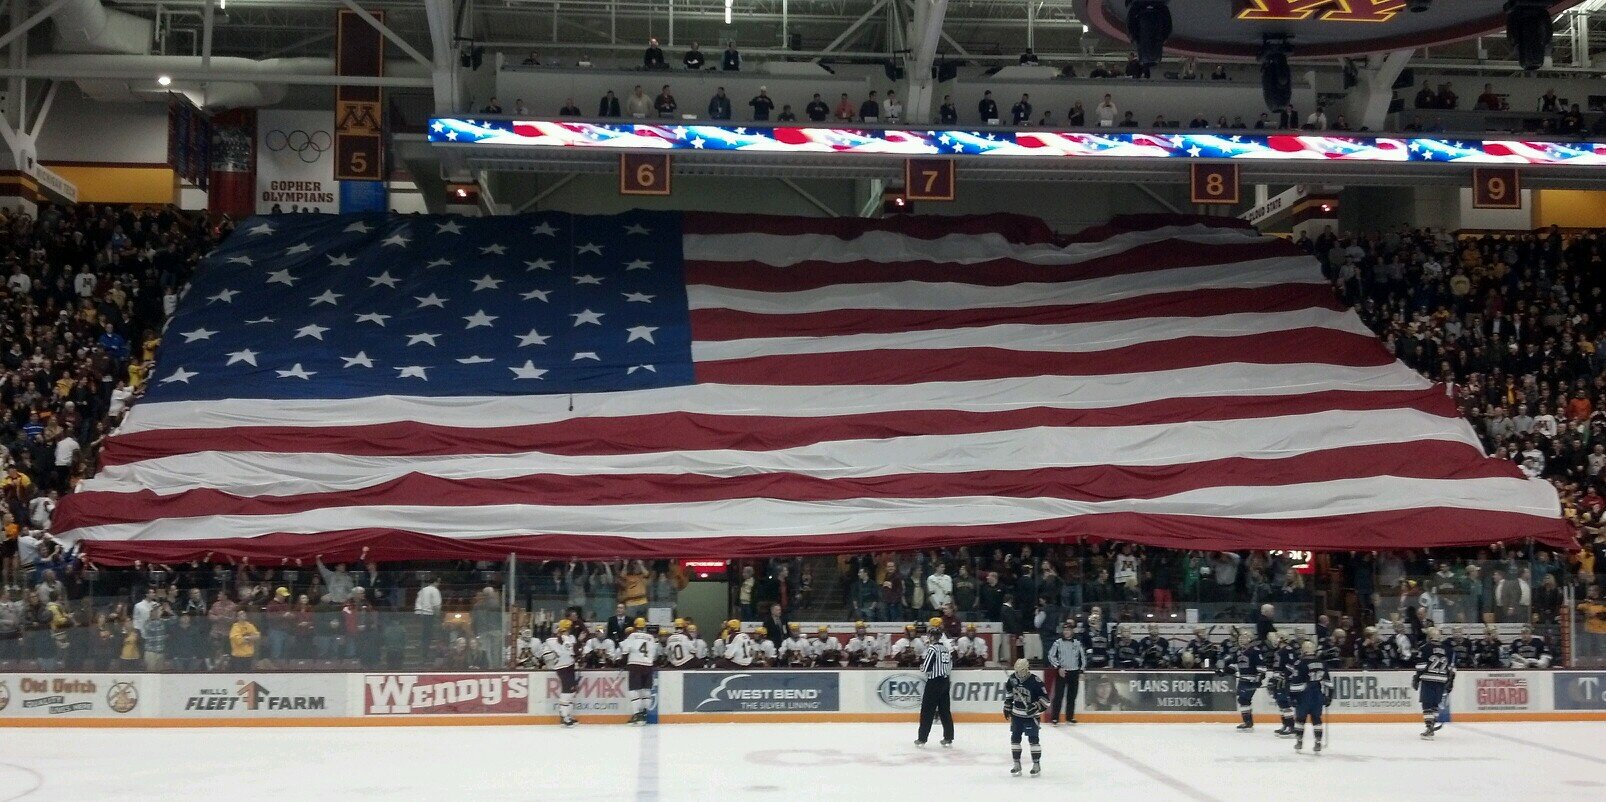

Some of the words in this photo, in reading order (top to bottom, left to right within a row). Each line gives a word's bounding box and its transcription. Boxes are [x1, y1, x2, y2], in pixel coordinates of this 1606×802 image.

[338, 104, 382, 131] M
[350, 152, 367, 173] 5
[637, 164, 654, 187] 6
[922, 170, 939, 193] 7
[270, 180, 321, 192] GOPHER
[1206, 173, 1224, 196] 8
[1487, 177, 1506, 200] 9
[262, 191, 334, 203] OLYMPIANS
[638, 641, 648, 657] 4
[727, 689, 772, 699] WEST
[773, 689, 818, 699] BEND
[889, 681, 920, 695] FOX
[951, 681, 1007, 701] ORTH
[1129, 680, 1169, 692] PLANS
[1172, 680, 1195, 692] FOR
[185, 697, 239, 710] FLEET
[269, 697, 325, 710] FARM
[1157, 698, 1203, 706] MEDICA
[1477, 687, 1528, 705] GUARD
